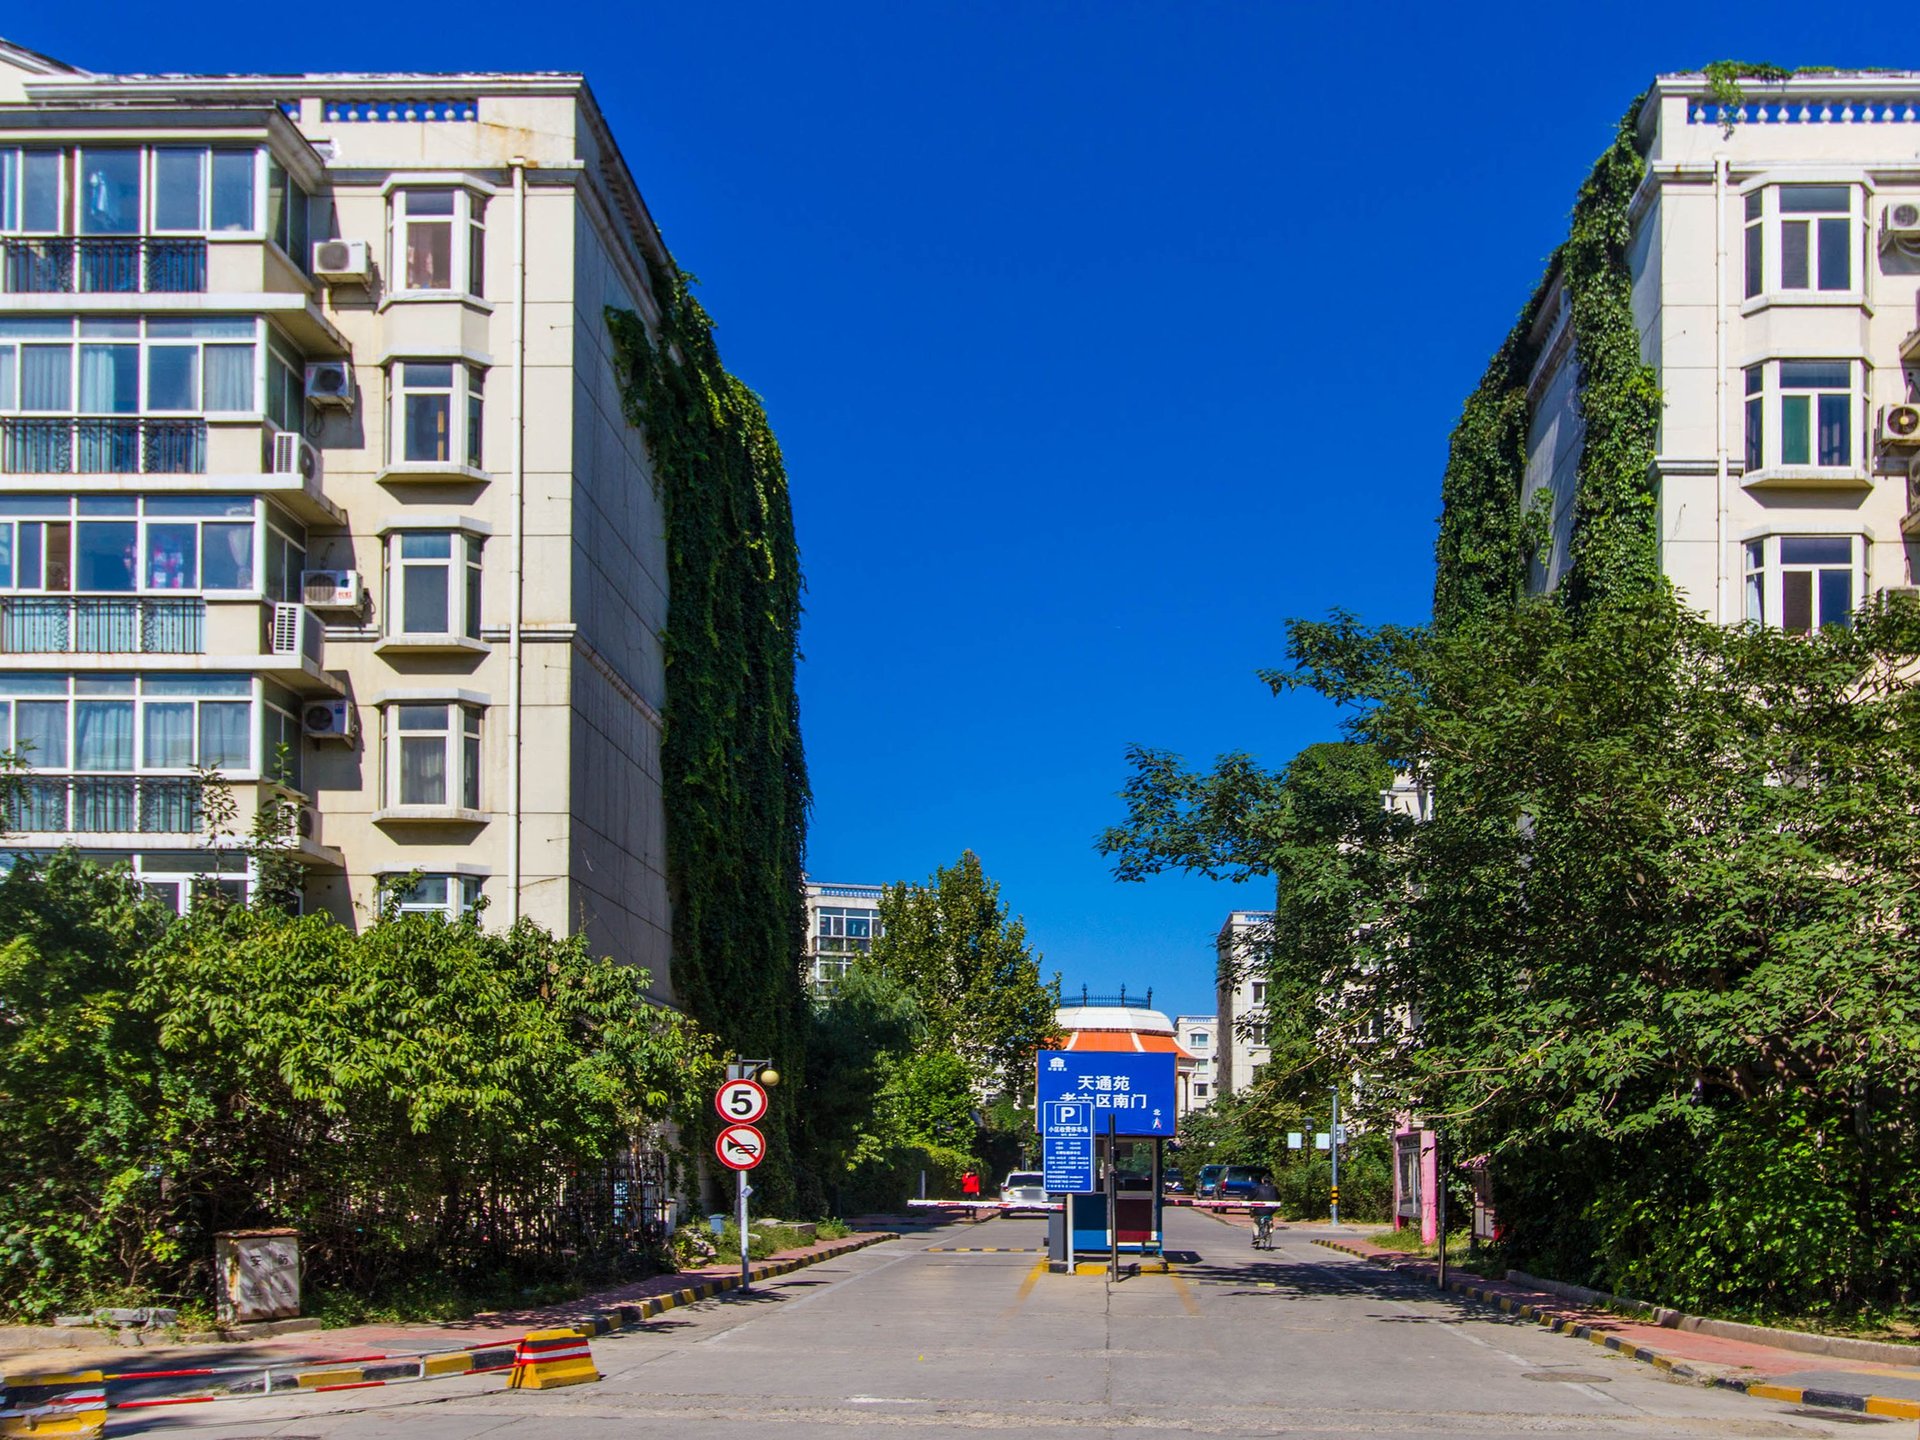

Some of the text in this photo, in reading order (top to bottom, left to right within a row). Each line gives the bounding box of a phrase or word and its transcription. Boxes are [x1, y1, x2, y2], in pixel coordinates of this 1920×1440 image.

[1078, 1075, 1130, 1091] 天通苑
[731, 1090, 753, 1116] 5
[1060, 1106, 1076, 1123] P
